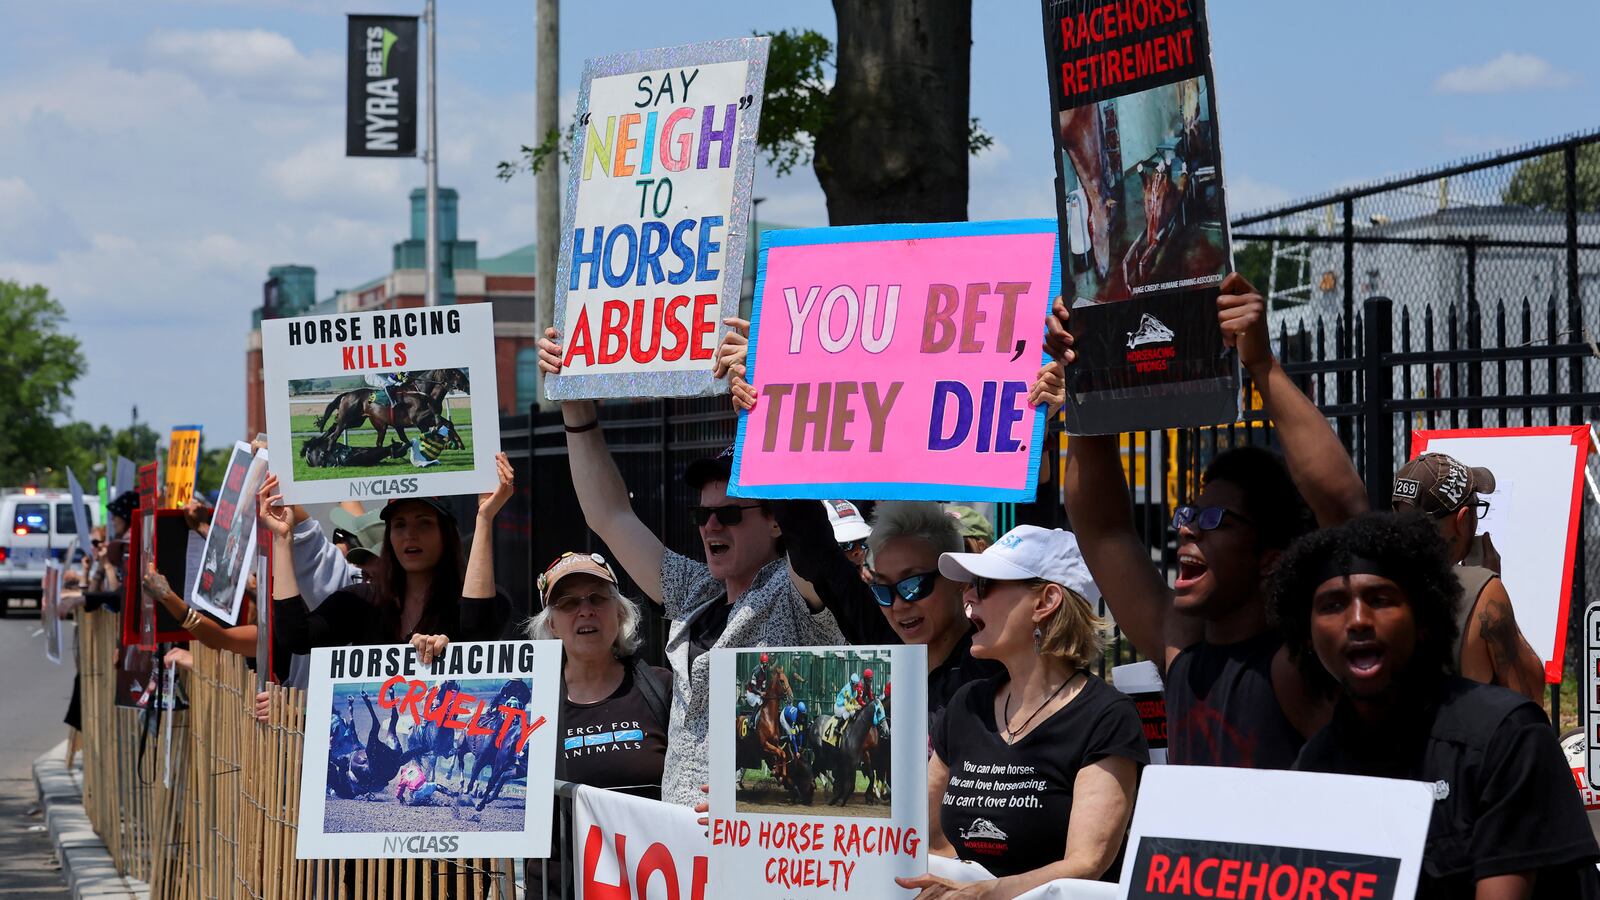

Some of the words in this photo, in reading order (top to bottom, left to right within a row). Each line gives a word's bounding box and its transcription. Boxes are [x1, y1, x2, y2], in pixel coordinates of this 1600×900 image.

[366, 26, 384, 77] BETS
[1062, 29, 1194, 97] RETIREMENT
[635, 69, 699, 109] SAY
[366, 77, 399, 151] NYRA
[636, 177, 673, 218] TO
[569, 215, 724, 291] HORSE
[289, 317, 362, 346] HORSE
[373, 309, 461, 339] RACING
[563, 294, 718, 367] ABUSE
[784, 284, 902, 354] YOU
[920, 281, 1032, 362] BET,
[342, 342, 408, 371] KILLS
[761, 380, 905, 453] THEY
[927, 380, 1029, 454] DIE.
[350, 477, 419, 497] NYCLASS
[1396, 481, 1416, 495] 269
[330, 646, 417, 679] HORSE
[431, 643, 534, 675] RACING
[377, 674, 547, 753] CRUELTY
[567, 724, 603, 736] ERCY
[612, 720, 640, 730] FOR
[824, 720, 835, 741] 4
[949, 775, 961, 787] You
[960, 779, 974, 788] can
[975, 779, 992, 790] love
[993, 779, 1048, 791] horseracing.
[963, 760, 977, 773] You
[977, 764, 990, 774] can
[990, 763, 1006, 775] love
[1006, 763, 1037, 775] horses.
[955, 795, 983, 807] can't
[984, 795, 1007, 808] love
[1008, 794, 1043, 808] both.
[383, 835, 459, 854] NYCLASS
[712, 819, 751, 847] END
[758, 821, 825, 854] HORSE
[833, 823, 922, 859] RACING
[765, 857, 856, 892] CRUELTY
[1145, 854, 1378, 900] RACEHORSE
